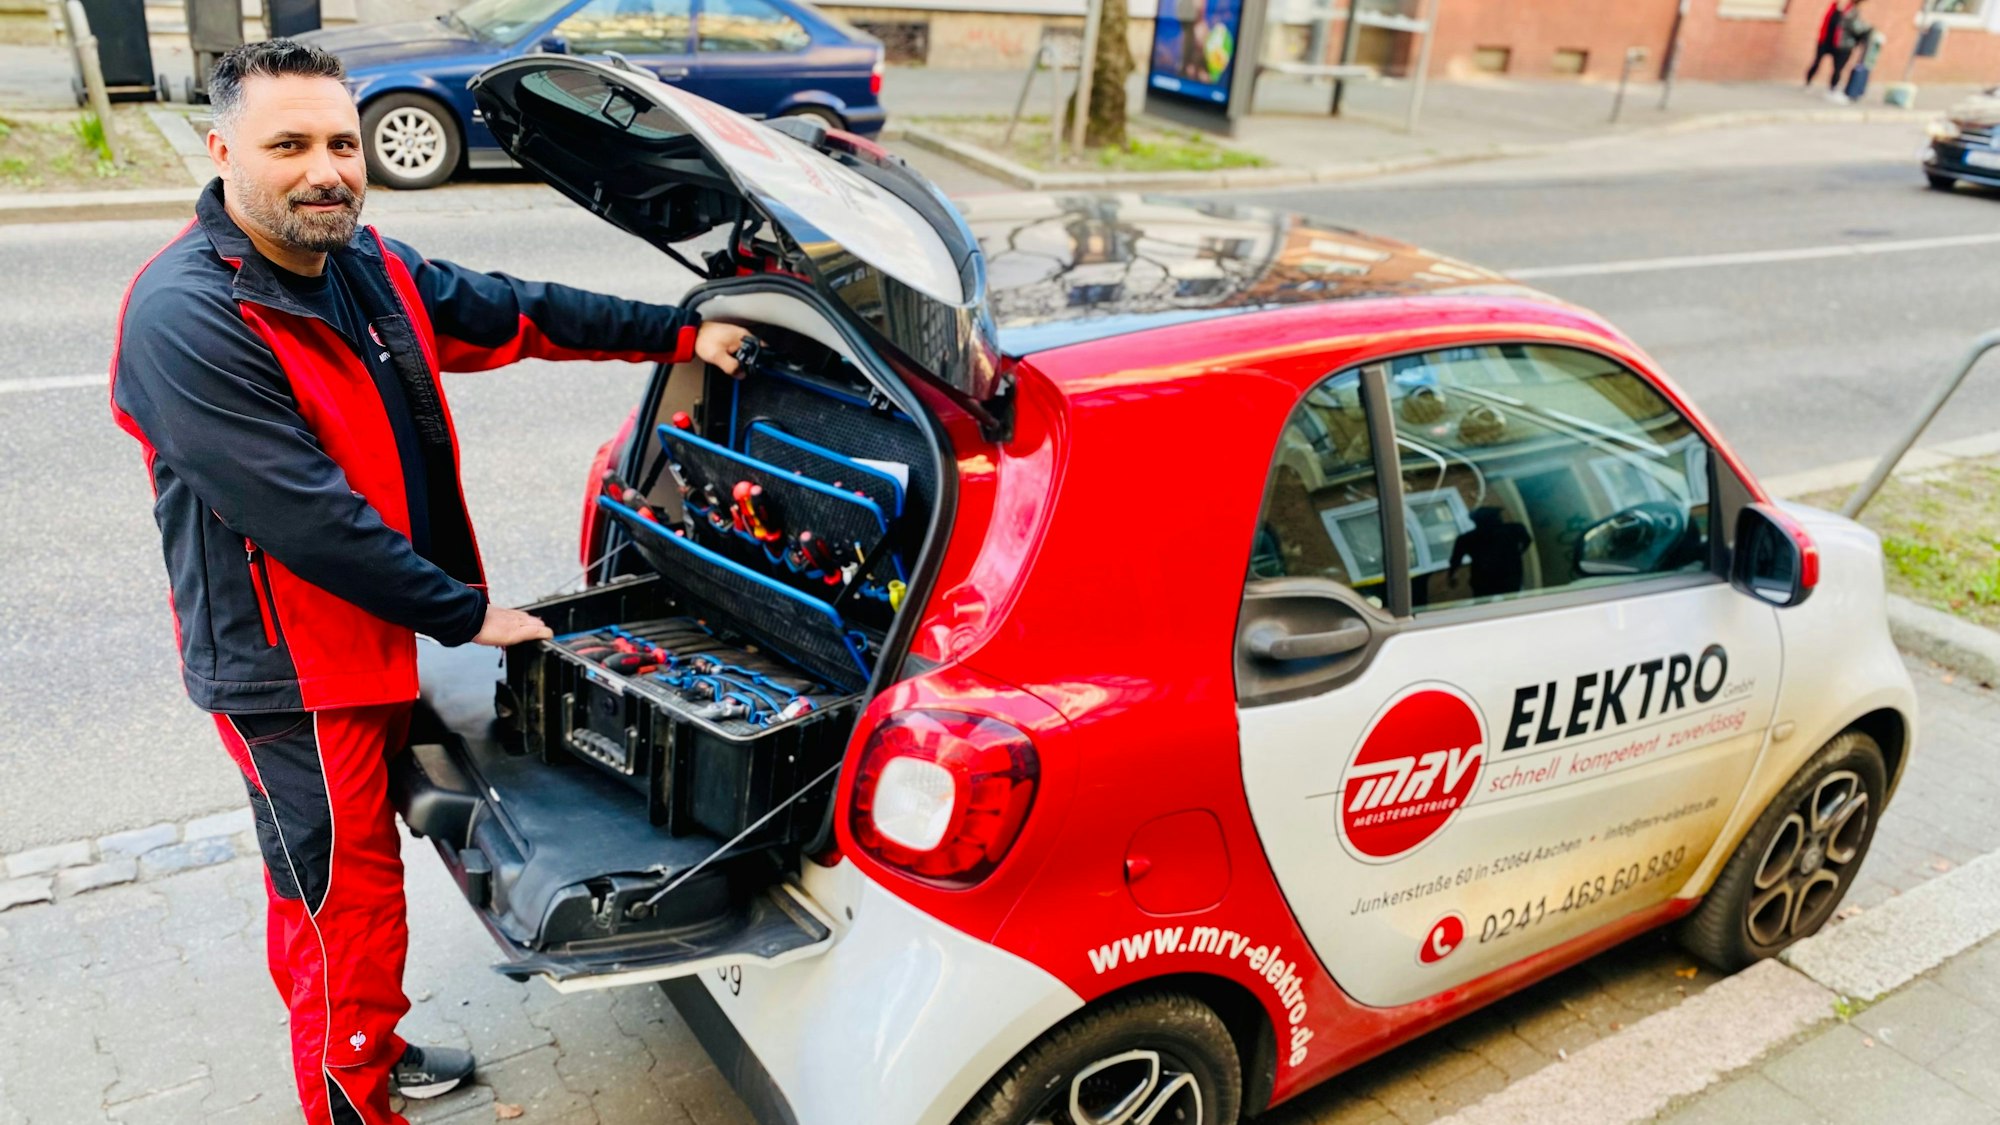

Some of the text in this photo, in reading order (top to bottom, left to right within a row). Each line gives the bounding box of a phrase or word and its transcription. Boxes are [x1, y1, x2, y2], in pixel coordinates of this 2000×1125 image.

[1501, 643, 1728, 752] ELEKTRO
[1348, 743, 1483, 813] MRV
[1489, 708, 1747, 793] schnell kompetent zuverlässig
[1353, 797, 1457, 828] MEISTERBETRIEB
[1350, 838, 1583, 916] Junkerstraße 60 in 52064 Aachen
[1479, 845, 1686, 944] 0241-468 60 889
[1088, 926, 1313, 1067] www.mrv-elektro.de
